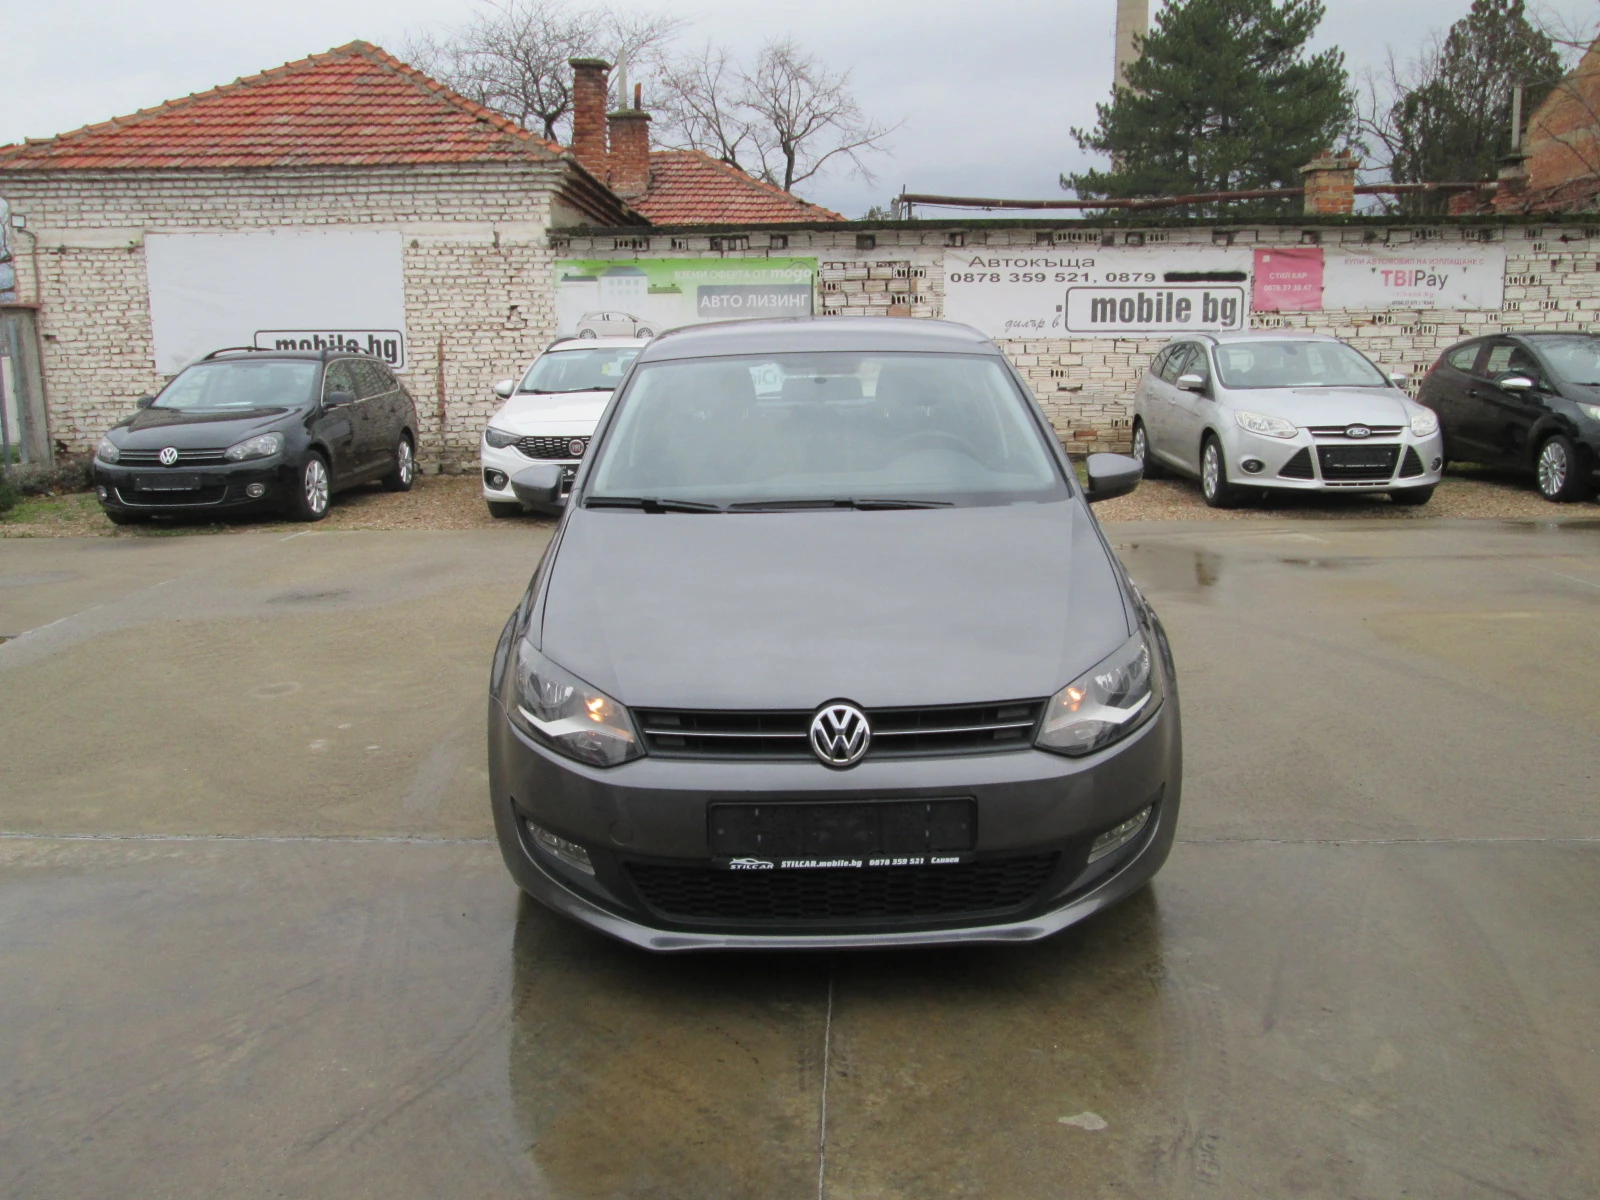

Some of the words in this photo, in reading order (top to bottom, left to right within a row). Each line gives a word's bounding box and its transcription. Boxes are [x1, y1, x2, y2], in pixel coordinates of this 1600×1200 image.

[968, 256, 1095, 269] Автокъща
[674, 270, 707, 279] ВЗЕМИ
[709, 269, 751, 279] ОФЕРТА
[752, 269, 766, 279] ОТ
[770, 268, 812, 282] mogo
[950, 272, 1001, 283] 0878
[1008, 272, 1046, 283] 359
[1054, 272, 1098, 284] 521,
[1105, 272, 1156, 283] 0879
[1380, 269, 1449, 291] TBIPay
[700, 294, 743, 308] АВТО
[746, 294, 809, 308] ЛИЗИНГ
[1090, 291, 1192, 323] mobile
[1201, 291, 1237, 327] bg
[161, 447, 177, 464] VW
[812, 706, 868, 763] VW
[781, 859, 863, 868] STILCAR.mobile.bg
[892, 858, 908, 866] 359
[909, 857, 924, 865] 521
